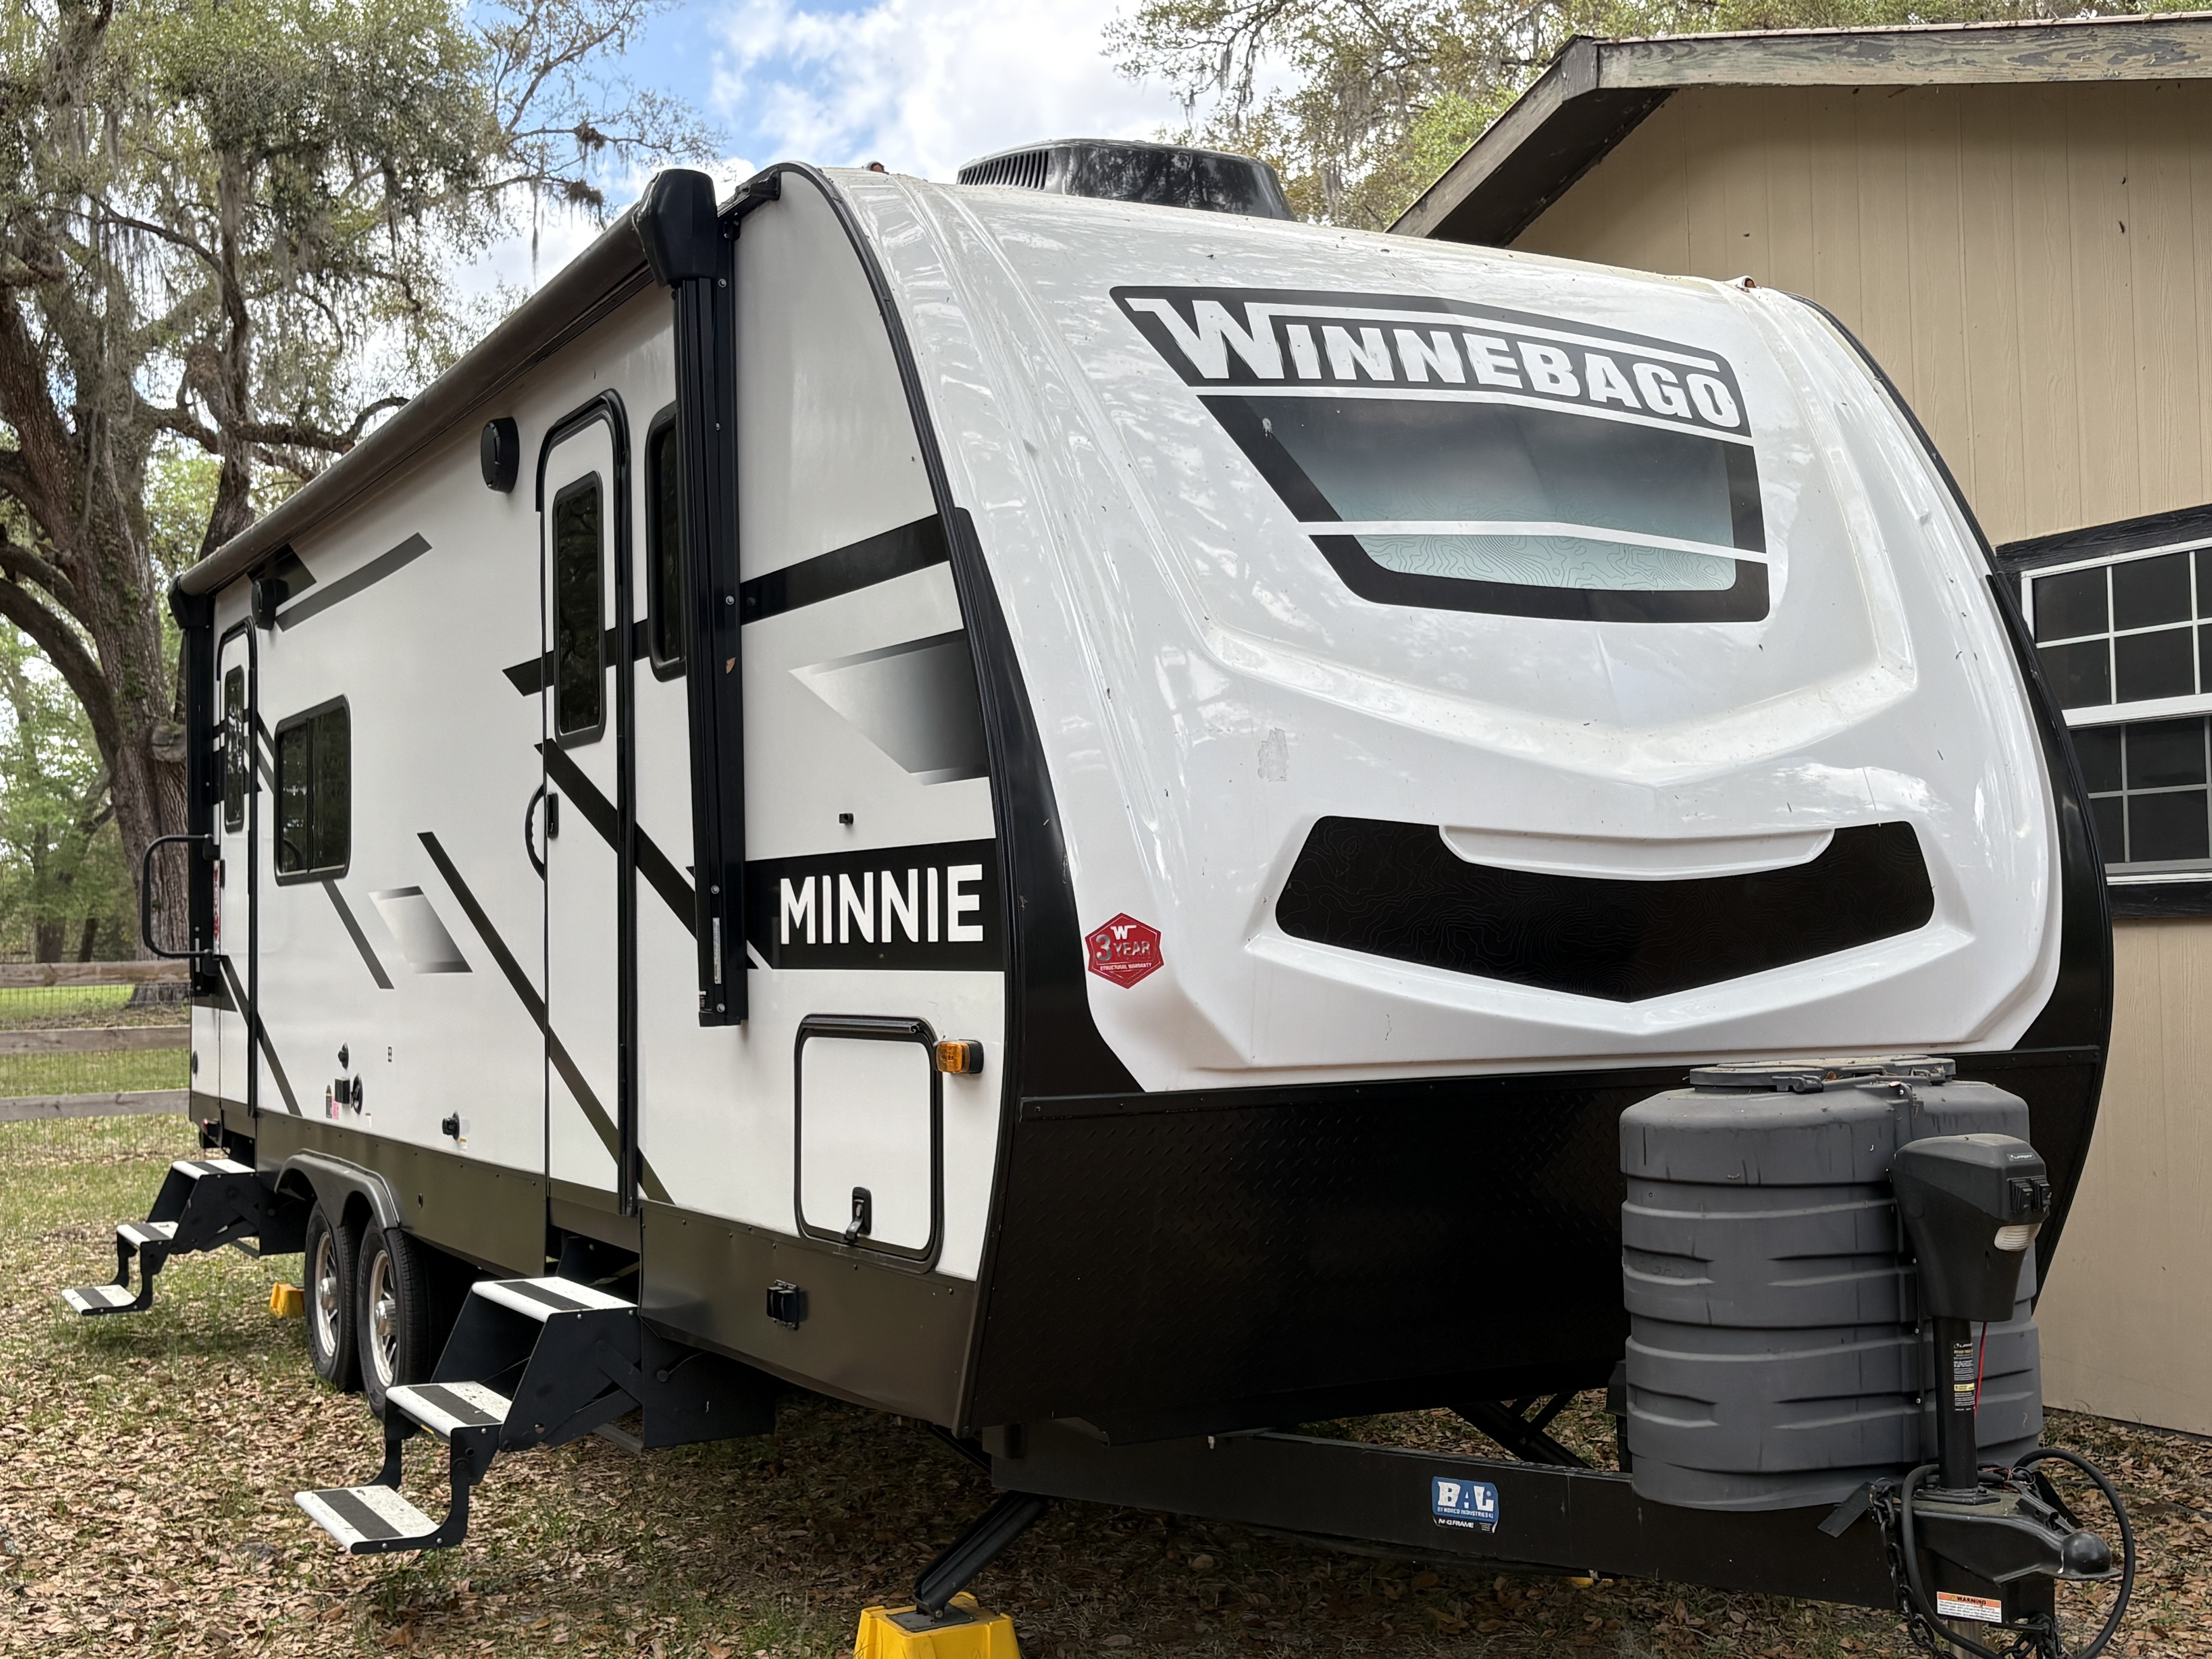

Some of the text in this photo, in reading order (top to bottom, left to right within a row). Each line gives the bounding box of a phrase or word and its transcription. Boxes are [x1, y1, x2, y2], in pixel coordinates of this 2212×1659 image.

[1133, 297, 1740, 428] WINNEBAGO
[780, 864, 983, 945] MINNIE
[1096, 934, 1150, 961] 3 YEAR
[1957, 1597, 1986, 1605] WARNING
